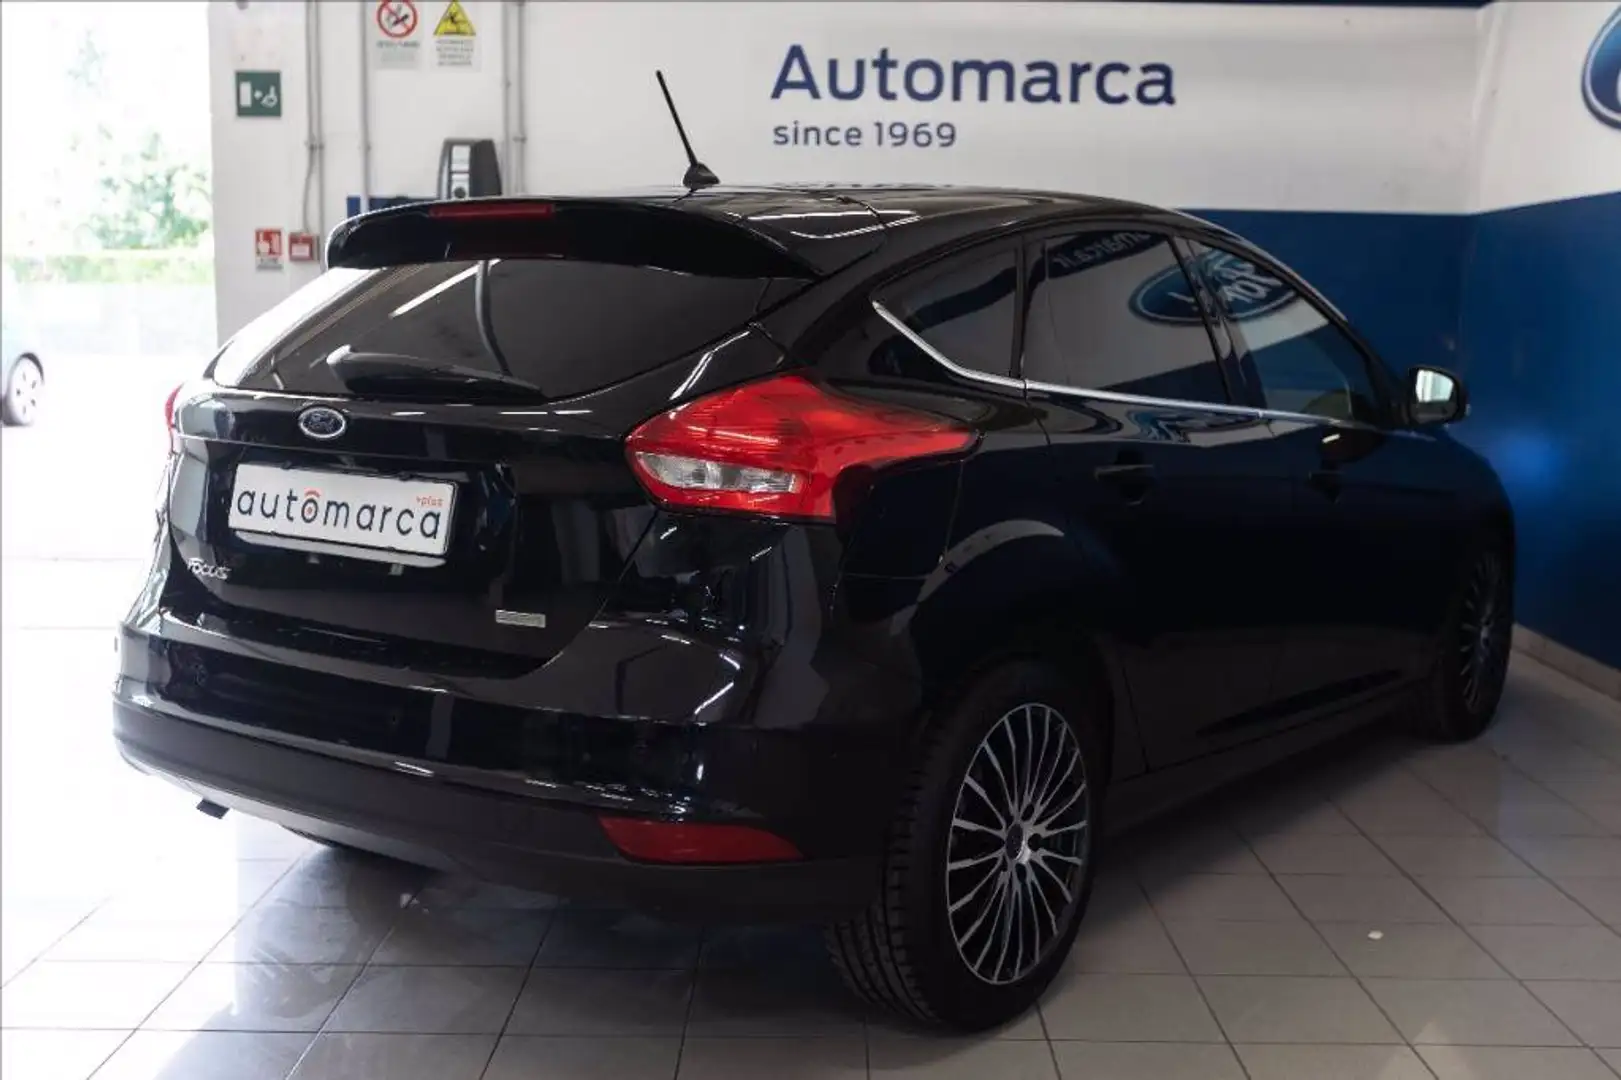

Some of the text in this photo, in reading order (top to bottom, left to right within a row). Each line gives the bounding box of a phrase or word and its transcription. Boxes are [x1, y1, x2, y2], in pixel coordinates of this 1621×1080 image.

[770, 44, 1176, 106] Automarca
[773, 120, 957, 149] since 1969
[236, 488, 441, 540] automarca
